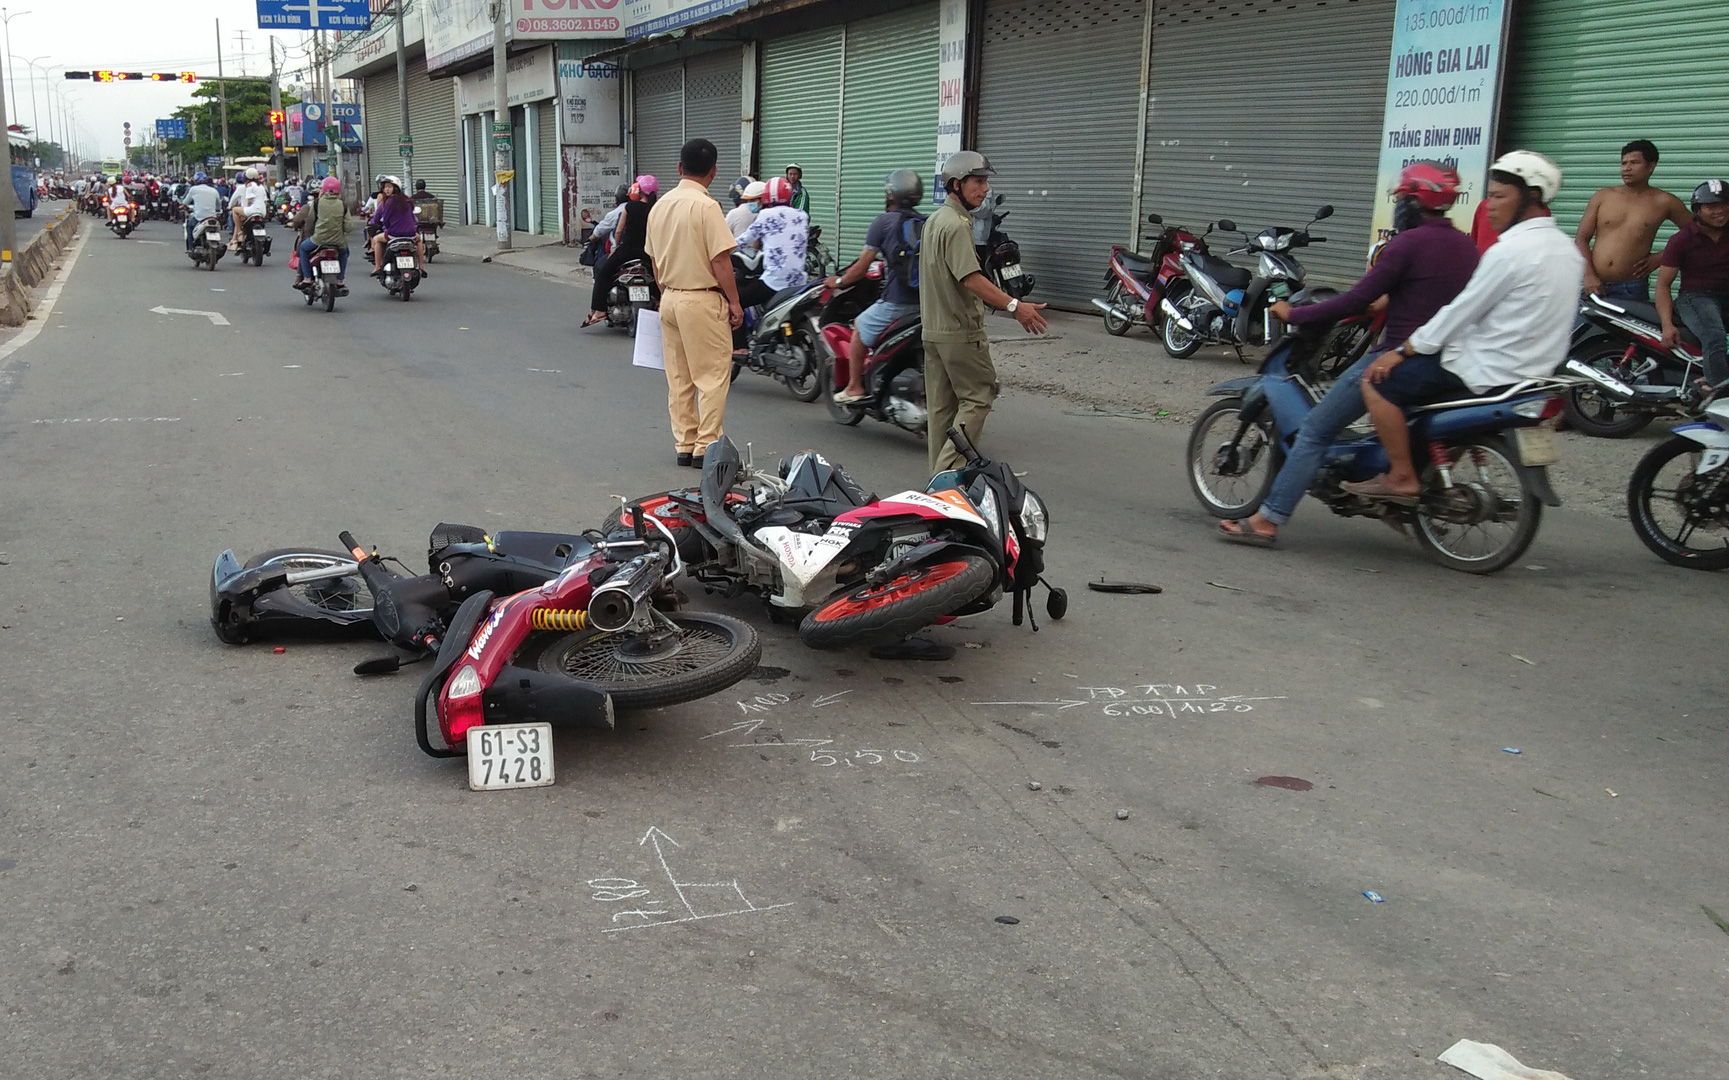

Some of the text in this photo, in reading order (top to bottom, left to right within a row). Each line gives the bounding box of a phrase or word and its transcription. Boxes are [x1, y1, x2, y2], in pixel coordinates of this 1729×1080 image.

[533, 18, 617, 31] 08.3602.1545
[1436, 48, 1460, 74] GIA
[1465, 44, 1491, 71] LAI
[99, 71, 113, 82] 96
[181, 72, 196, 83] 27
[560, 63, 584, 78] KHO
[269, 110, 284, 124] 27
[1388, 123, 1482, 150] TRẮNG BÌNH ĐỊNH
[826, 526, 854, 539] RK
[819, 538, 843, 548] NGK
[782, 541, 797, 569] HONDA
[480, 728, 541, 757] 61-S3
[481, 756, 542, 786] 7428
